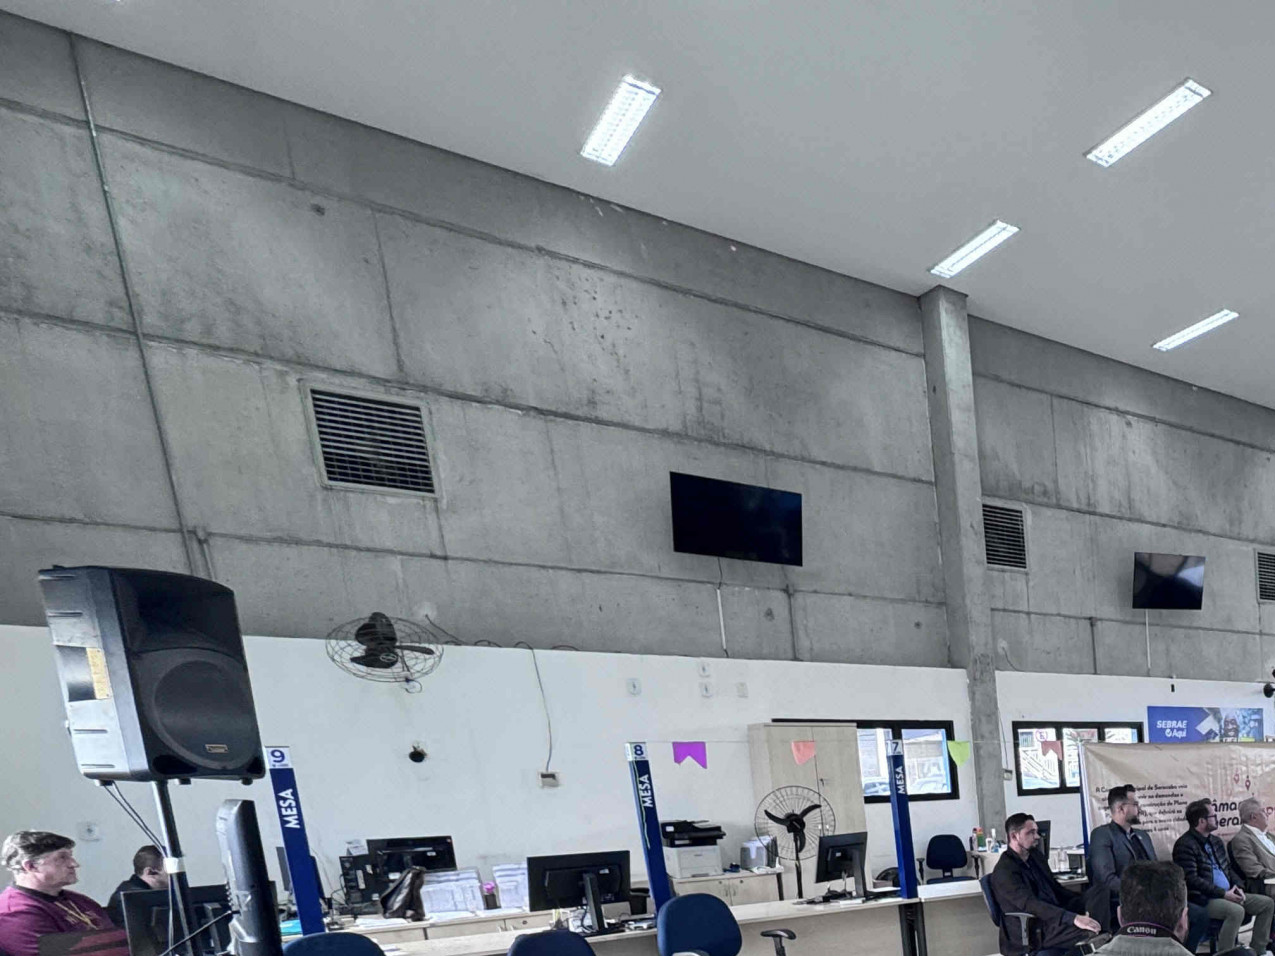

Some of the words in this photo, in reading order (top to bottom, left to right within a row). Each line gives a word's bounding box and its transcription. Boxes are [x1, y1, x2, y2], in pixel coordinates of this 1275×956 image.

[1156, 720, 1188, 729] SEBRAE
[1172, 729, 1187, 738] Aqui
[634, 744, 644, 756] 8
[892, 741, 899, 751] 7
[270, 749, 285, 763] 9
[895, 765, 906, 795] MESA
[639, 774, 654, 808] MESA
[277, 788, 301, 829] MESA
